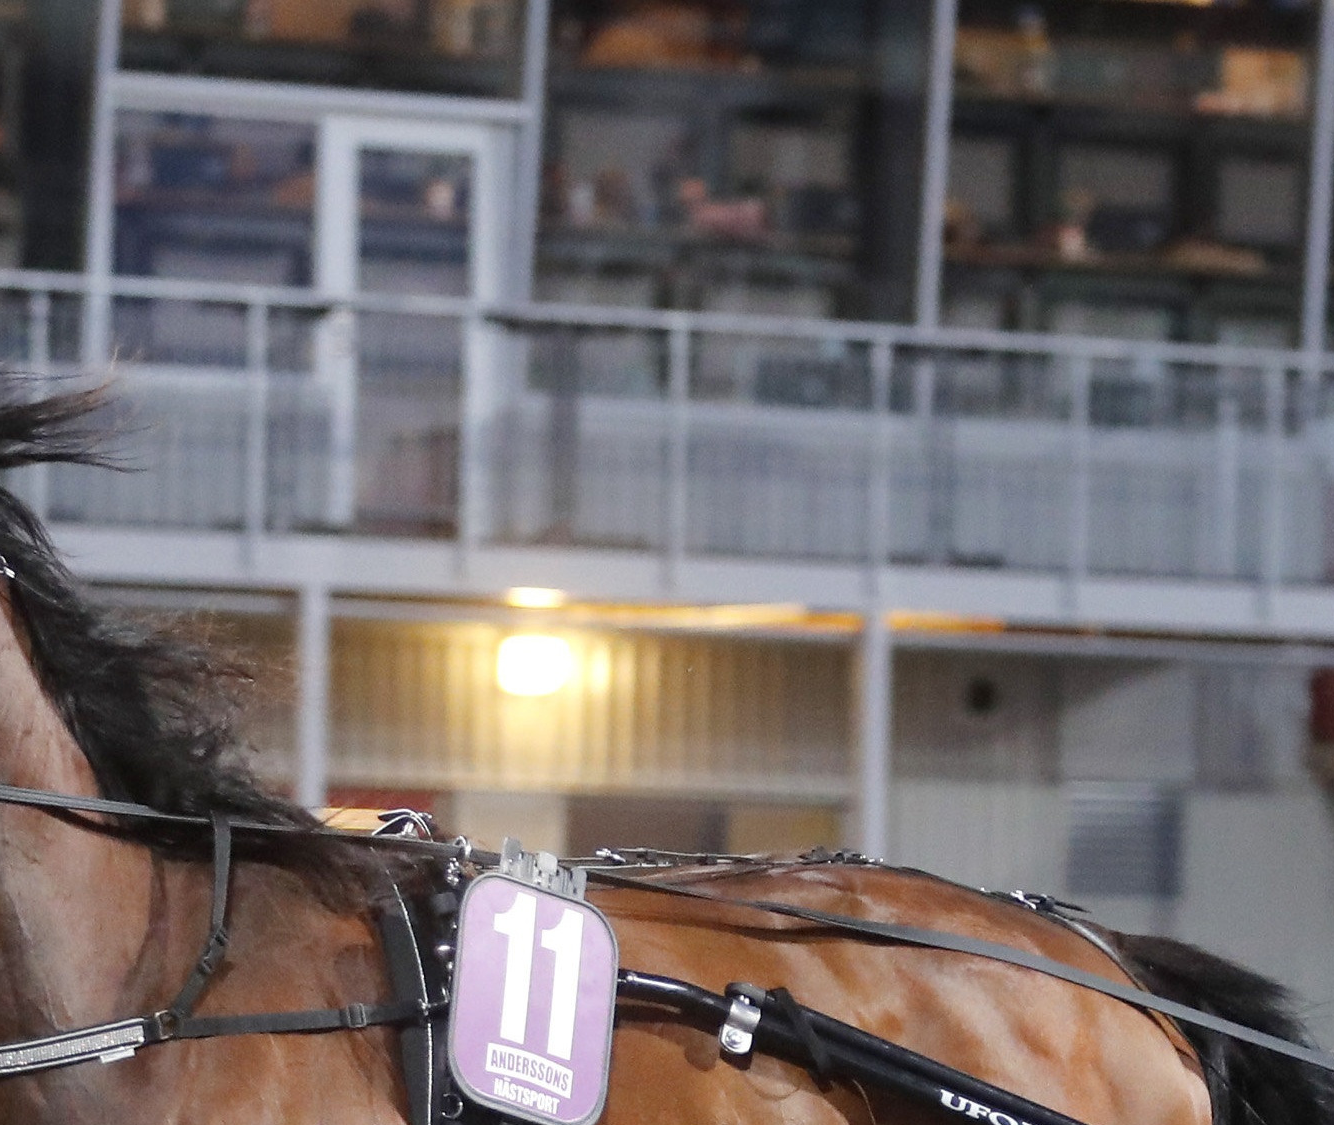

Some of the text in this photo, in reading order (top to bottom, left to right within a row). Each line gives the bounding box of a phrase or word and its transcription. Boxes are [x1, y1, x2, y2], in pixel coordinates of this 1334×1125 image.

[493, 892, 584, 1061] 11
[490, 1049, 570, 1092] ANDERSSONS
[493, 1075, 561, 1115] HÄSTSPORT
